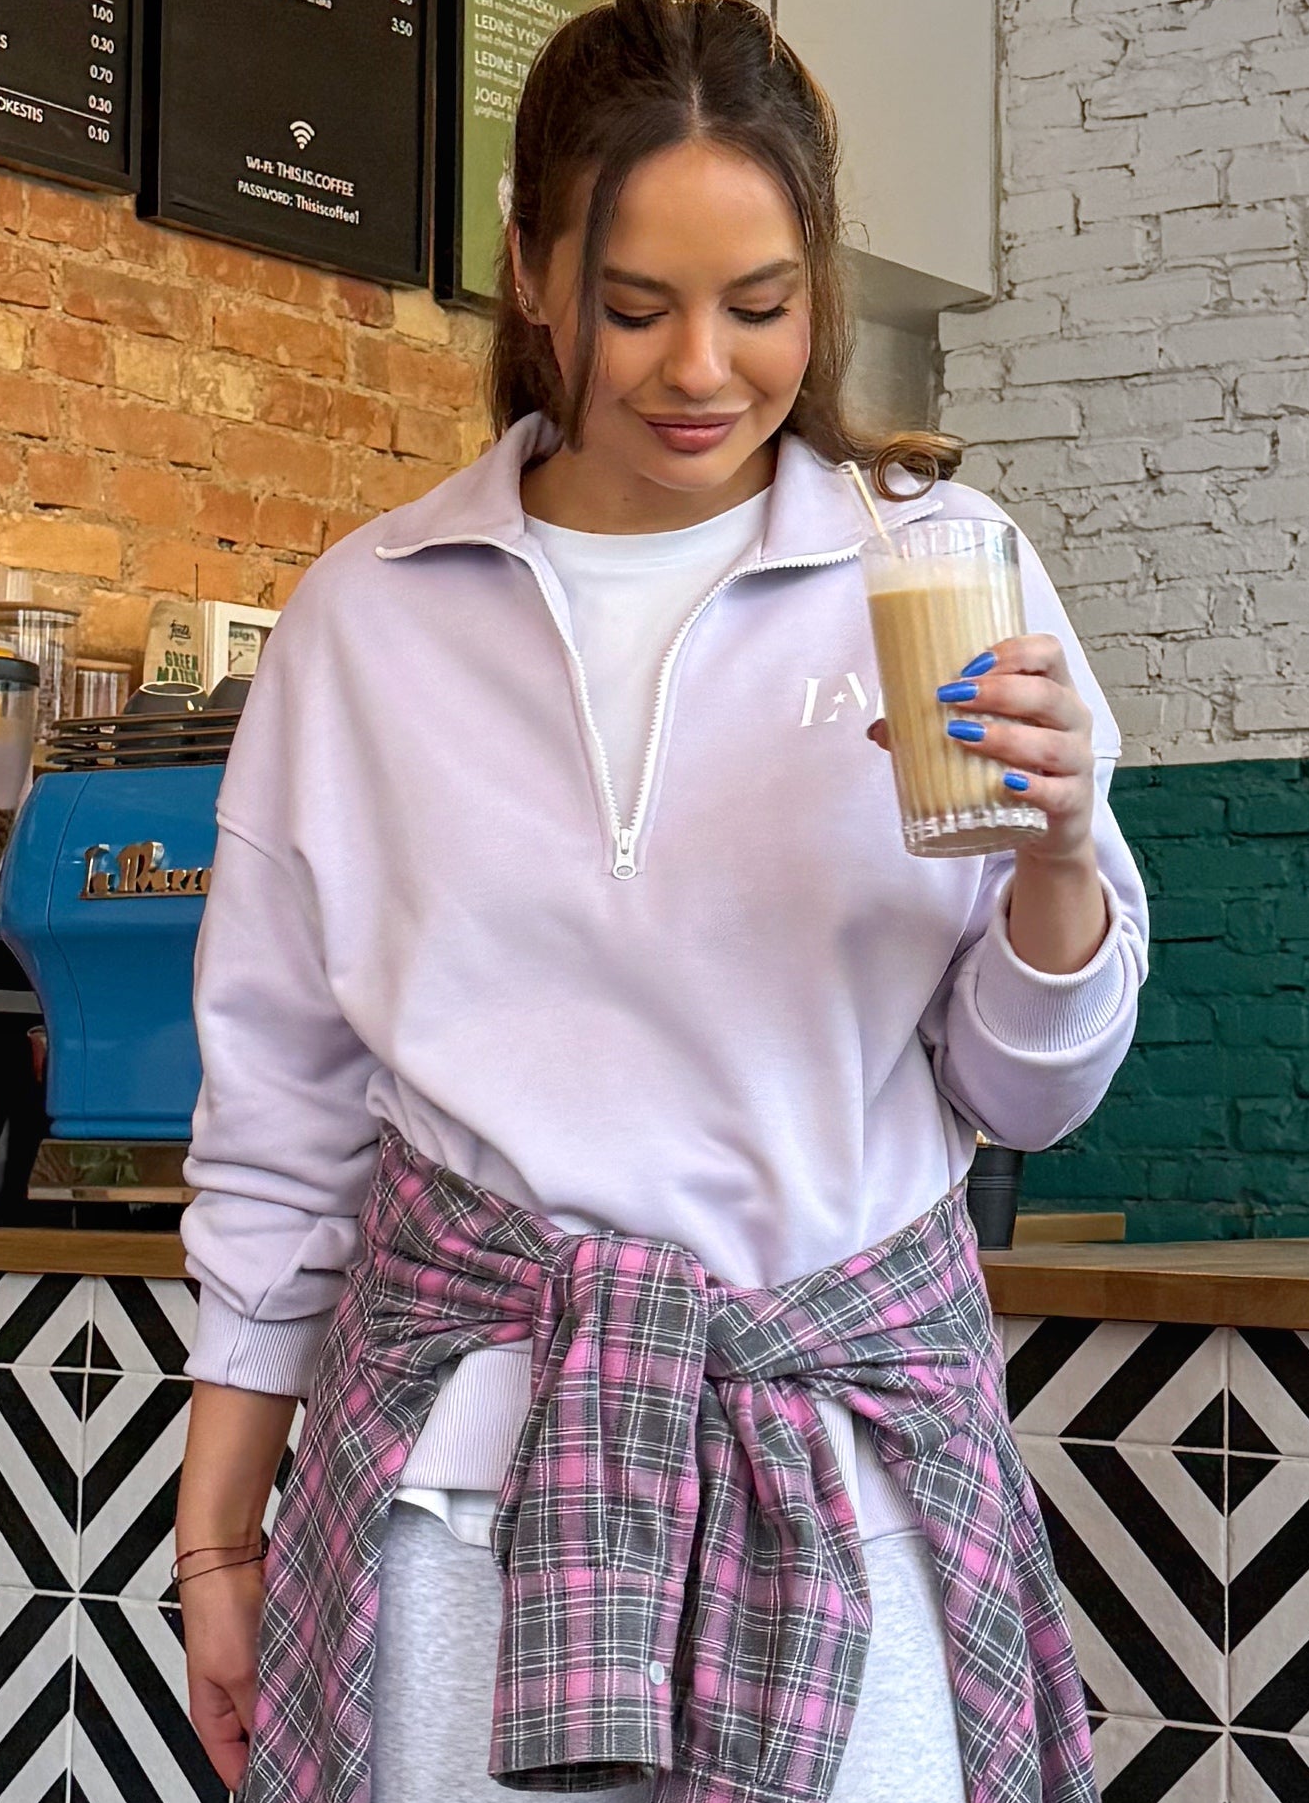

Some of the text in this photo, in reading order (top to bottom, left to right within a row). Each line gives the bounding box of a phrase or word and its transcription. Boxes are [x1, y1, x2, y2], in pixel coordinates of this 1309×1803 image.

[92, 4, 114, 24] 1.00
[391, 17, 413, 37] 3.50
[91, 34, 114, 54] 0.30
[90, 64, 113, 84] 0.70
[88, 94, 112, 114] 0.30
[88, 125, 110, 143] 0.10
